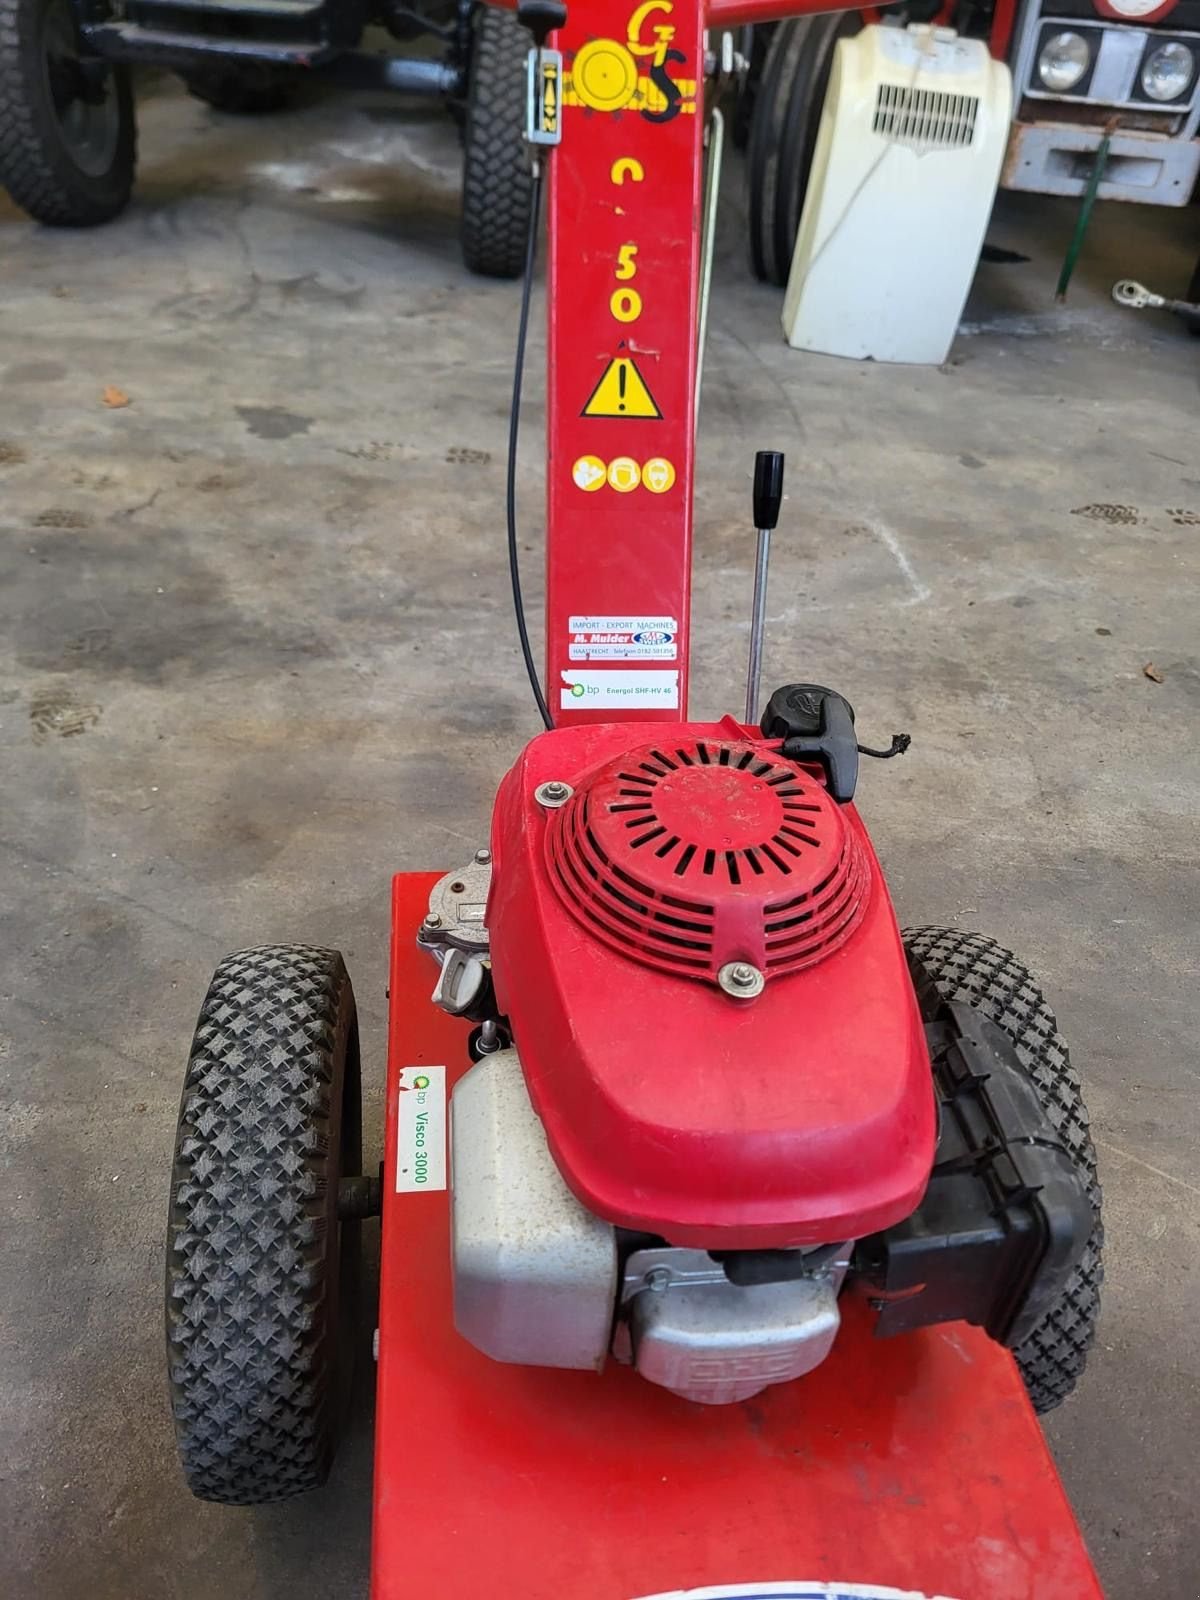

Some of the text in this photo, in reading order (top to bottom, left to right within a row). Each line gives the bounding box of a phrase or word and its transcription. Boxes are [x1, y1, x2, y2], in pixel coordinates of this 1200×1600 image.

[572, 621, 600, 629] IMPORT
[606, 621, 633, 629] EXPORT
[637, 621, 674, 629] MACHINES
[574, 633, 630, 643] M. Mulder
[587, 685, 600, 694] bp
[606, 687, 634, 695] Energol
[414, 1091, 429, 1184] bp Visco 3000
